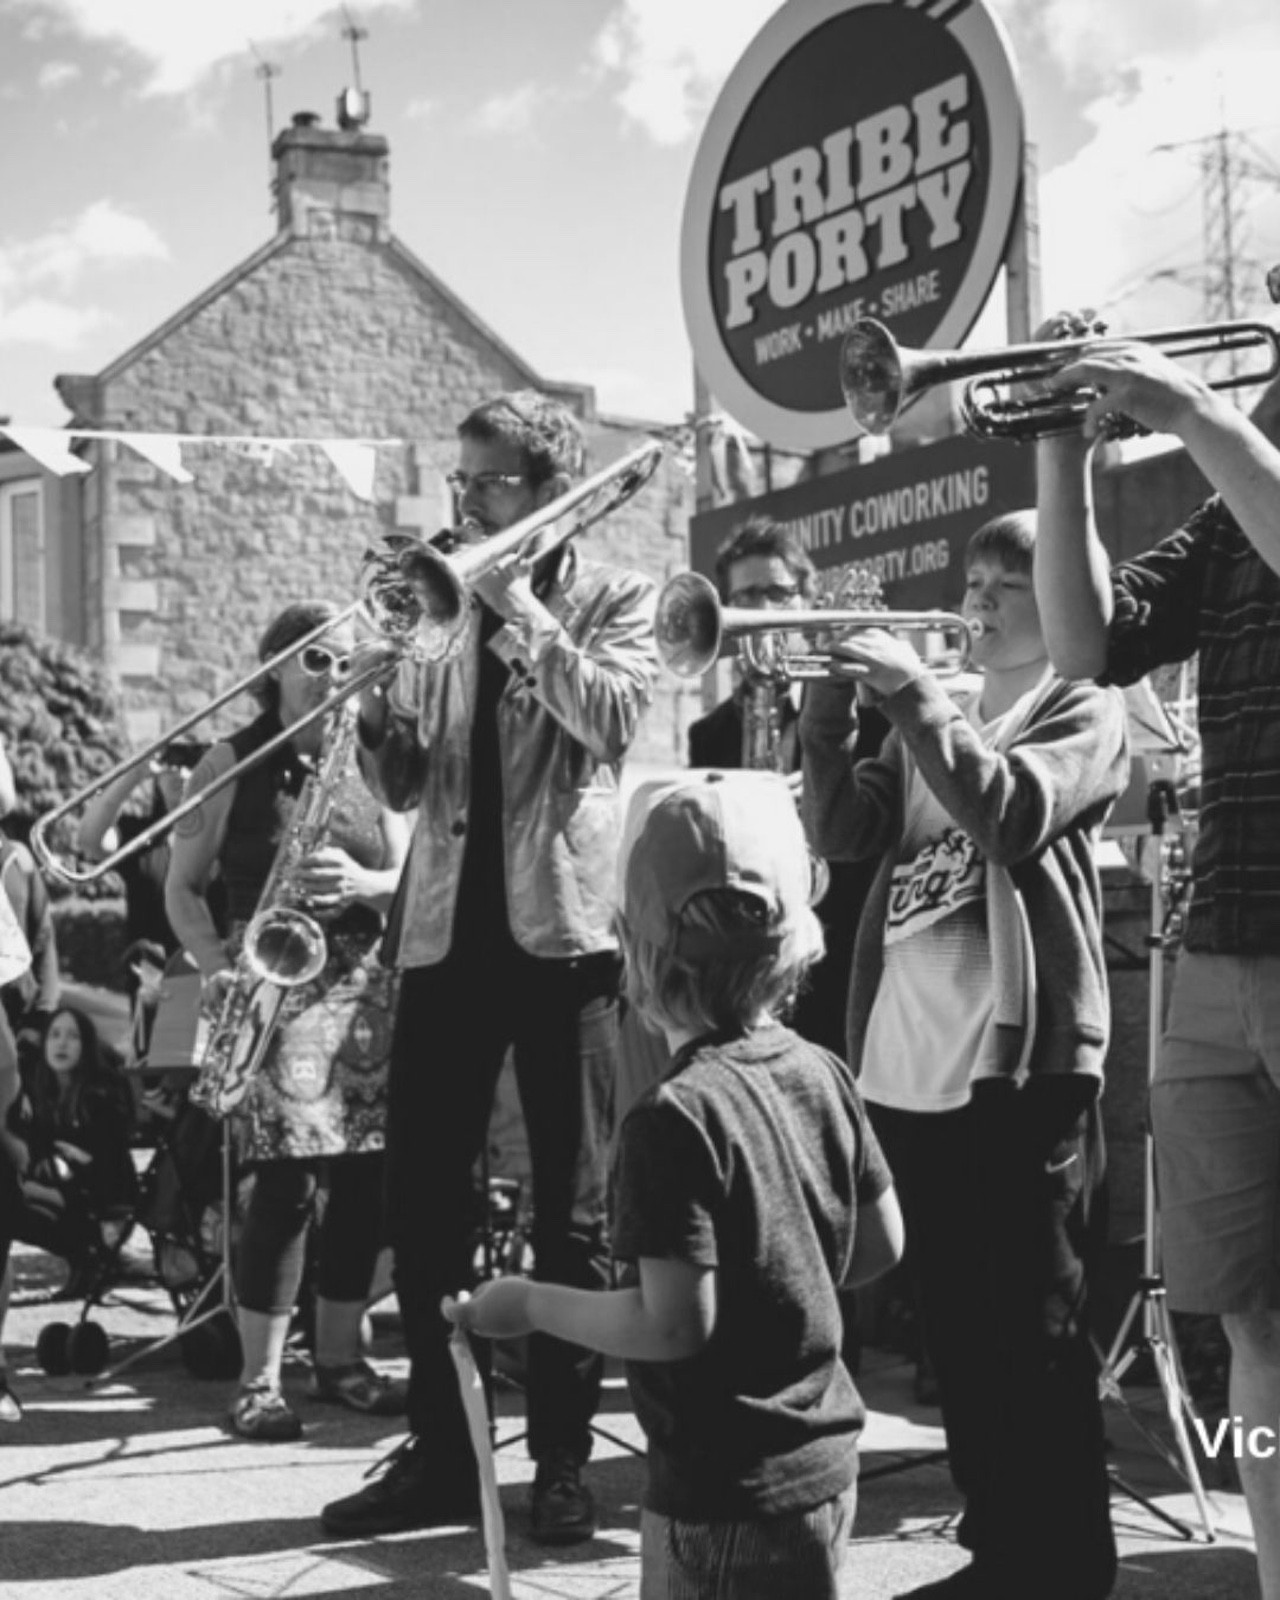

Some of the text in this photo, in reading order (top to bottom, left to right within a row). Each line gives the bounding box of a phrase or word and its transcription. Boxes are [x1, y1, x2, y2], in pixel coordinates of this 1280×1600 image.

[721, 73, 970, 256] TRIBE
[724, 160, 972, 329] PORTY
[754, 269, 941, 366] WORK MAKE SHARE
[851, 465, 990, 539] COWORKING
